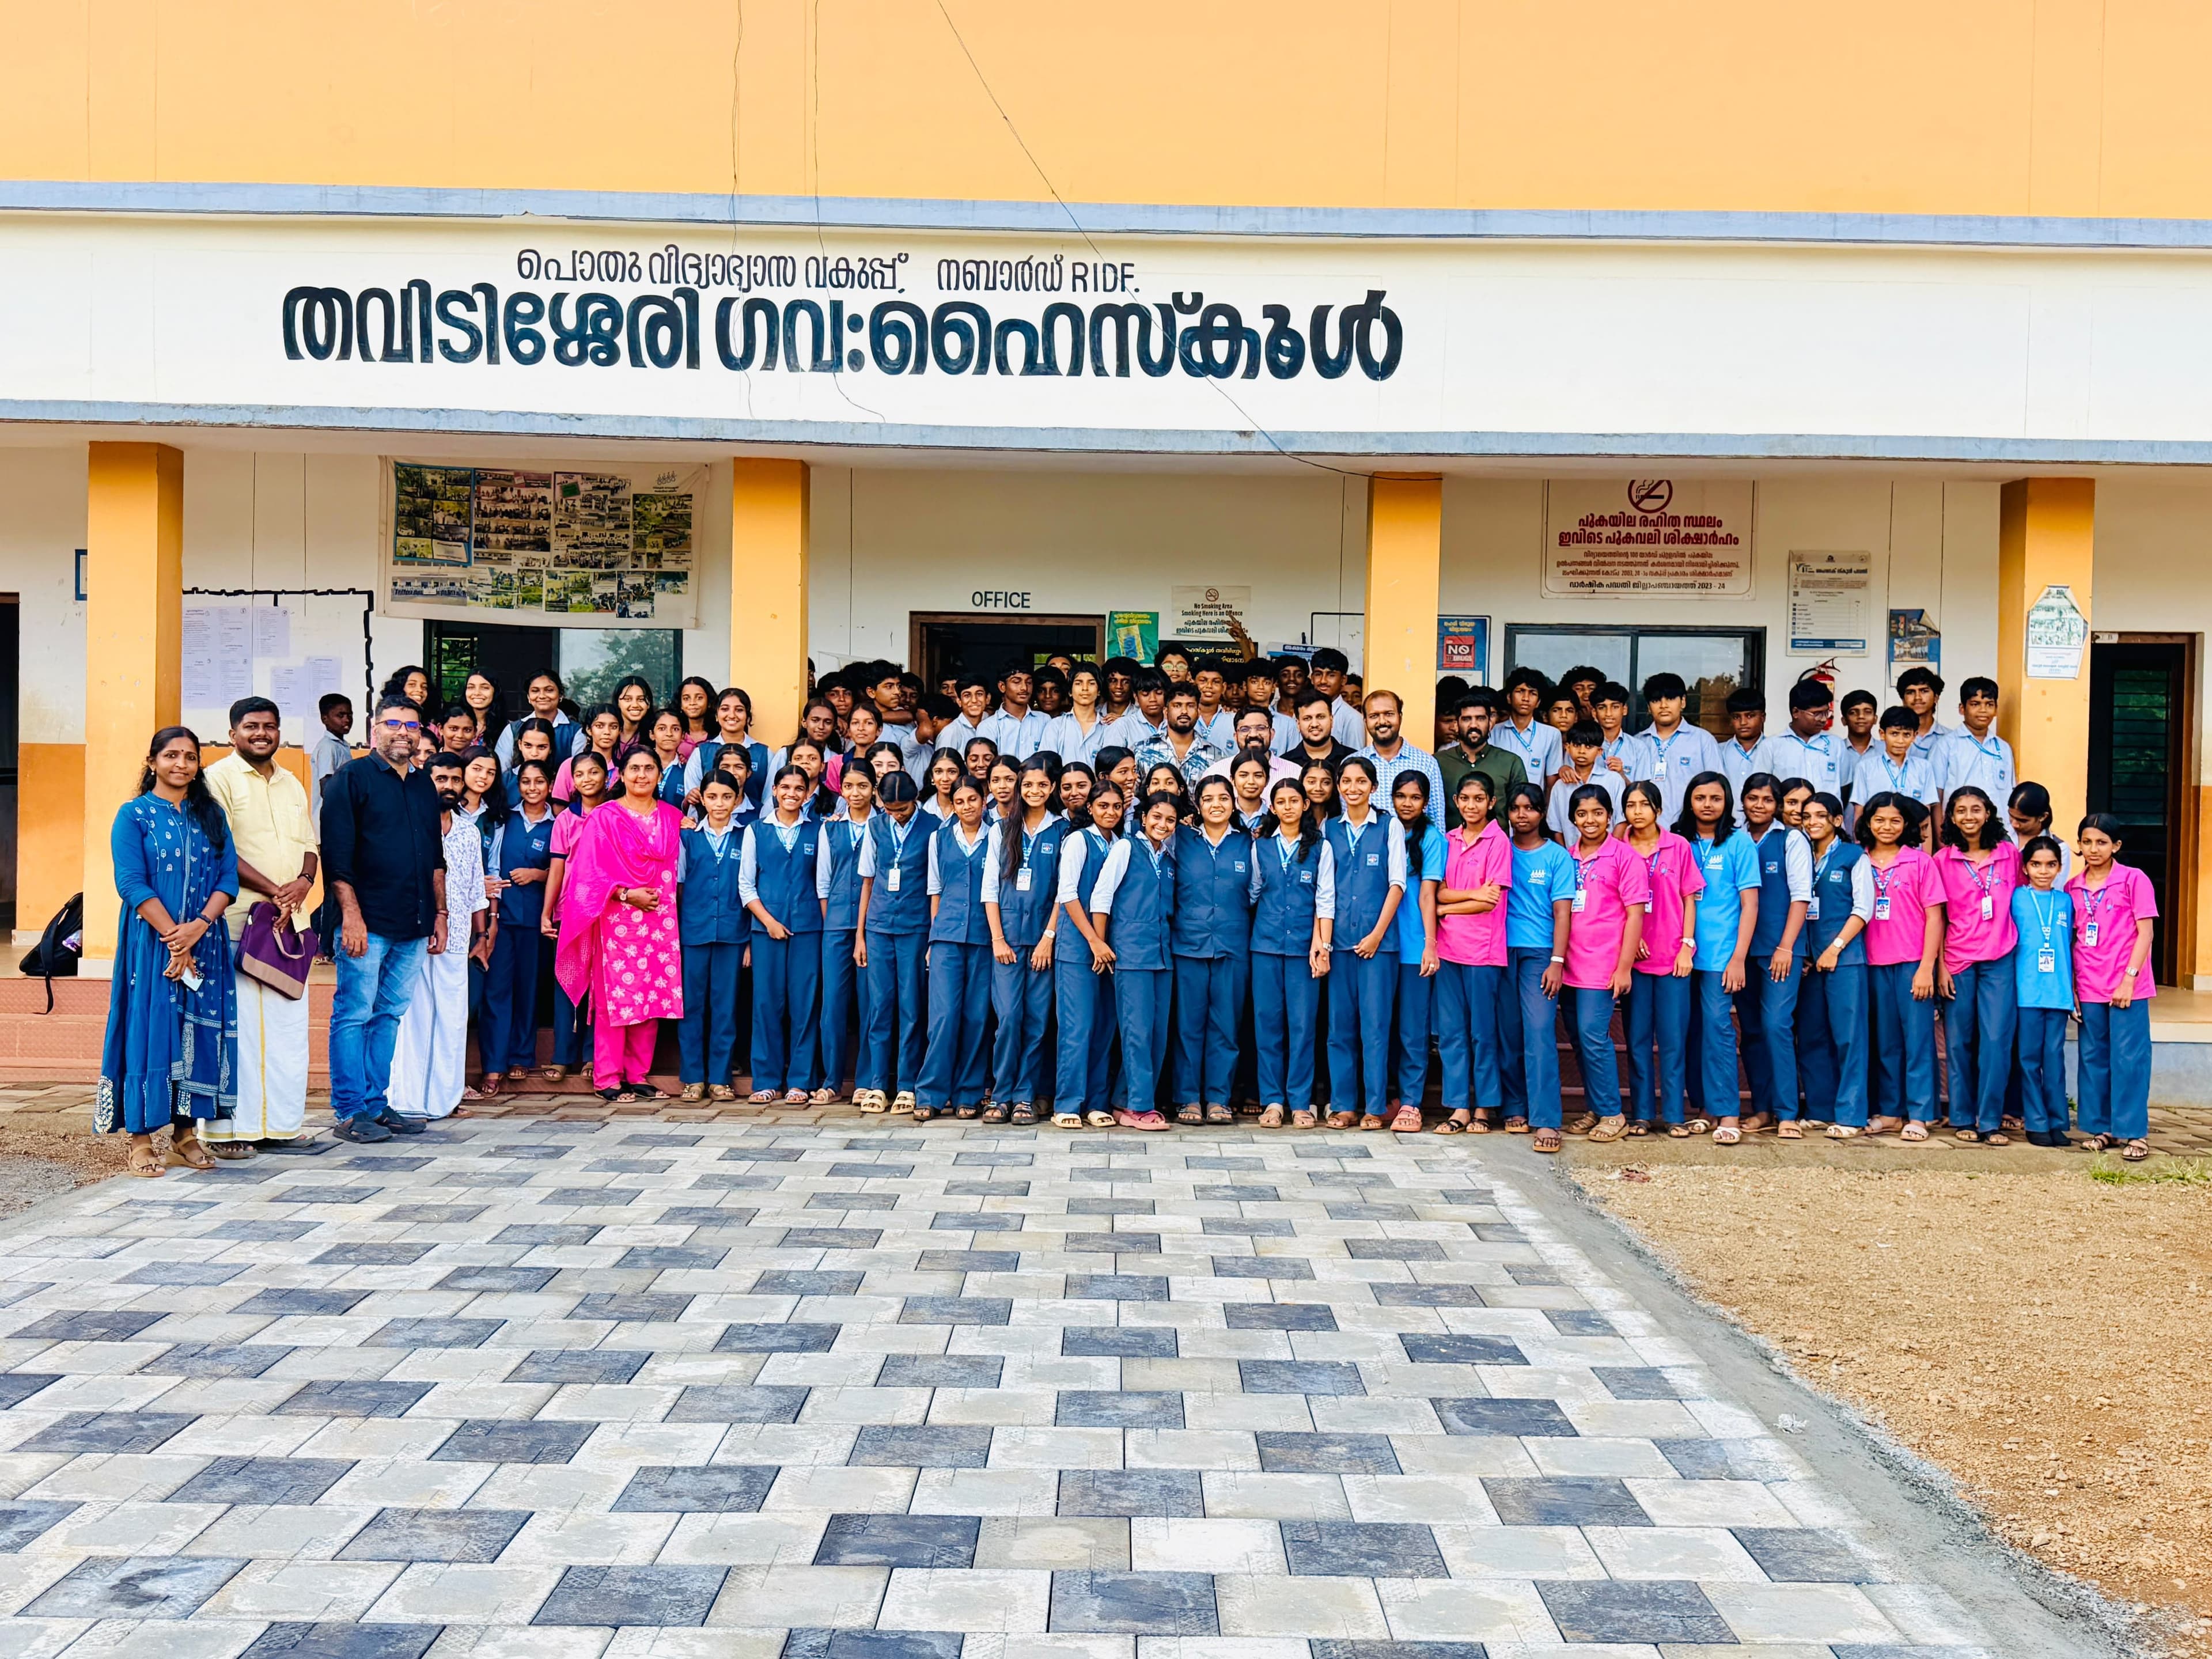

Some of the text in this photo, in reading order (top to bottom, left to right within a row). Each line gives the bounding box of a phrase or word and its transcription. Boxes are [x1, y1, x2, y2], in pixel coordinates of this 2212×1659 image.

[518, 249, 641, 282] പൊതു
[649, 244, 796, 293] വിദ്യാഭ്യാസ
[937, 254, 1063, 292] നബാർഡ്
[1578, 511, 1723, 528] പുകയില രഹിത സ്ഥലം
[1558, 528, 1740, 547] ഇവിടെ പുകവലി ശിക്ഷാർഹം
[972, 591, 1031, 608] OFFICE
[1448, 645, 1470, 655] NO
